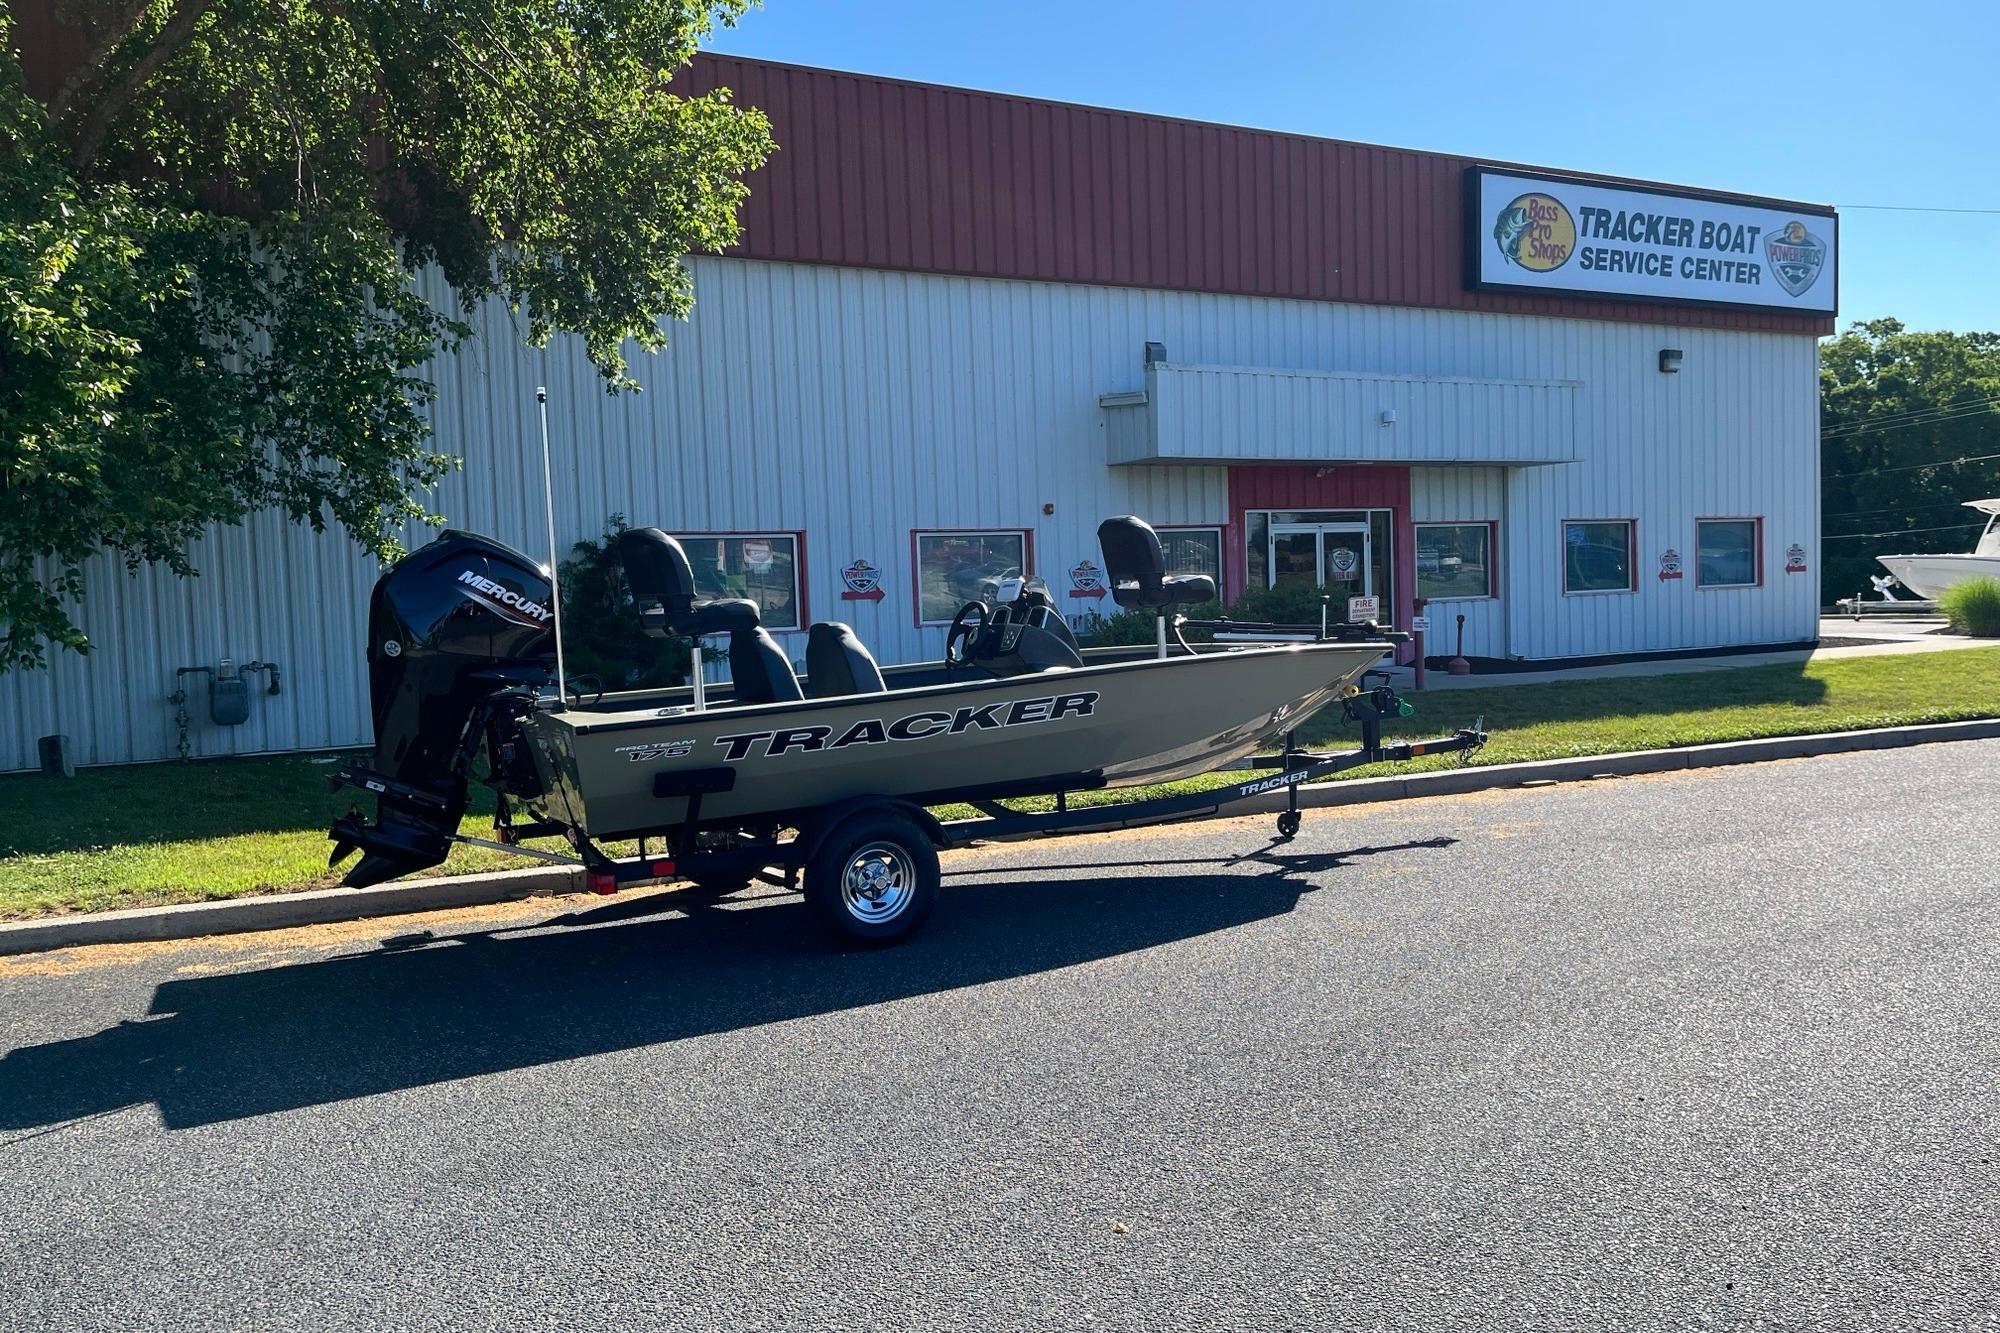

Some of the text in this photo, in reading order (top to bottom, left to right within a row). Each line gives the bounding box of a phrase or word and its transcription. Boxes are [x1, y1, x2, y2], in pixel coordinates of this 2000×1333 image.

[1527, 198, 1559, 221] Bass
[1528, 219, 1552, 239] Pro
[1579, 206, 1761, 254] TRACKER BOAT
[1528, 237, 1567, 264] Shops
[1579, 246, 1674, 277] SERVICE
[1680, 256, 1761, 285] CENTER
[457, 570, 554, 621] MERCURY
[1355, 599, 1373, 608] FIRE
[713, 691, 1101, 762] TRACKER
[614, 739, 697, 753] PRO TEAM
[628, 745, 692, 762] 175
[1239, 770, 1309, 796] TRACKER
